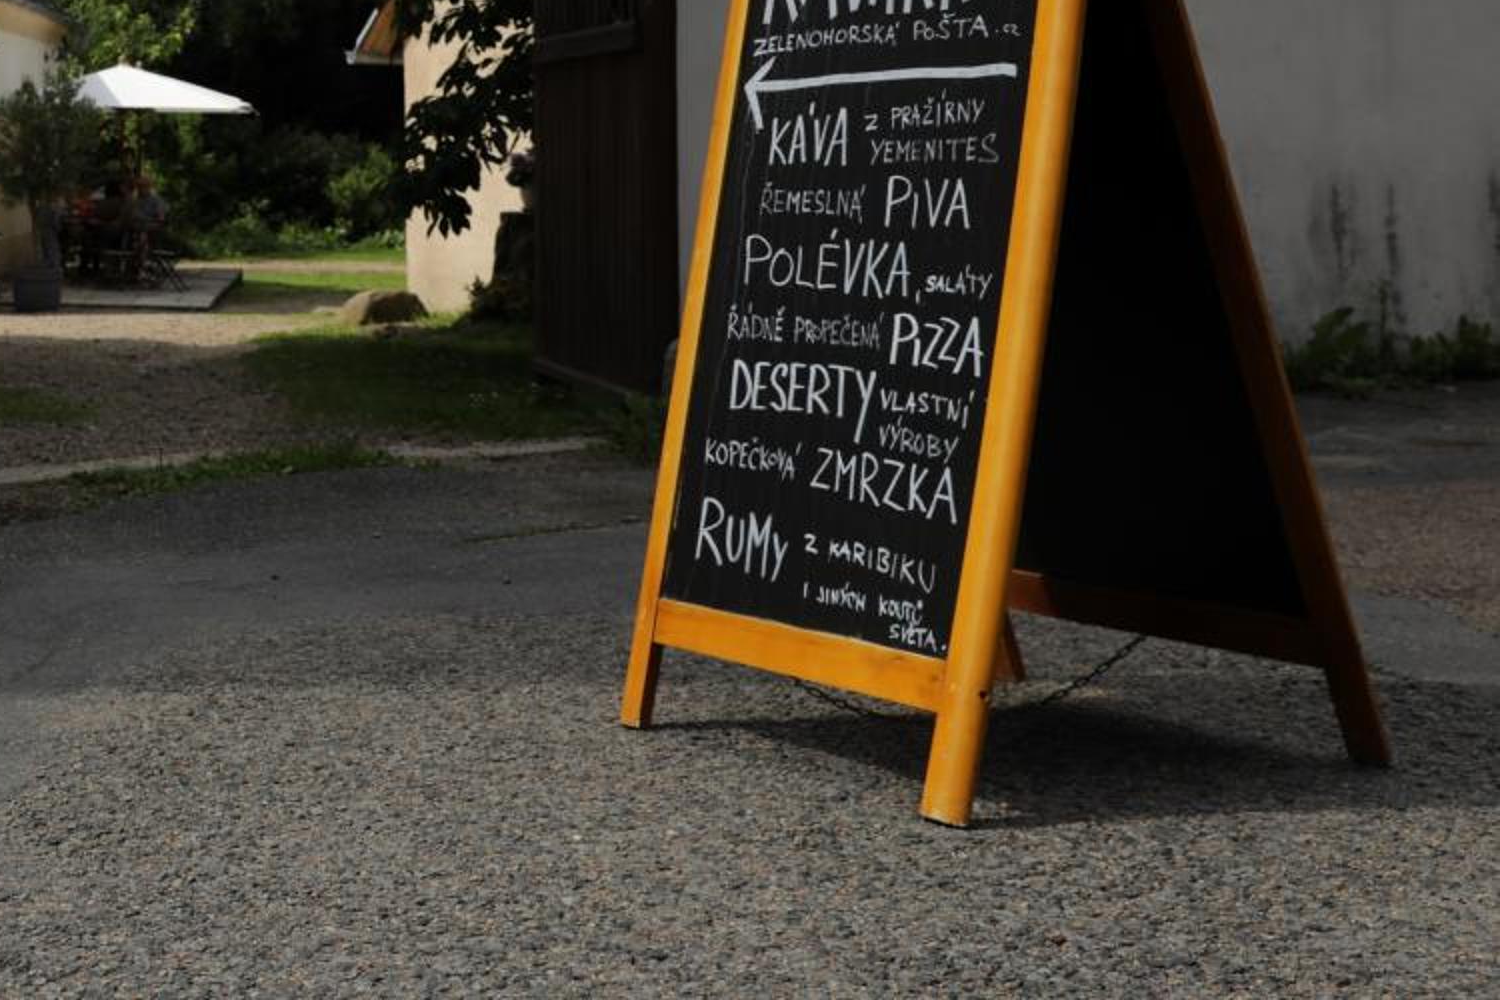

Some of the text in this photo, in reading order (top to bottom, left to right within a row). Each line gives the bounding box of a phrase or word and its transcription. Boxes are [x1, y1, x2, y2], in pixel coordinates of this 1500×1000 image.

[753, 22, 900, 57] ZELENOHORSKÁ
[768, 101, 848, 167] KÁVA
[890, 88, 986, 130] PRAŽÍRNY
[868, 132, 1000, 166] YEMENITES
[759, 181, 867, 225] ŘEMESLNÁ
[924, 264, 993, 300] SALÁTY
[793, 311, 885, 350] PROPEČENÁ
[729, 359, 976, 444] DESERTY VLASTNÍ
[879, 414, 959, 463] VÝROBY
[705, 436, 957, 525] KOPEČKOVÁ ZMRZKA
[695, 496, 788, 582] RUMY
[829, 540, 935, 594] KARIBIKU
